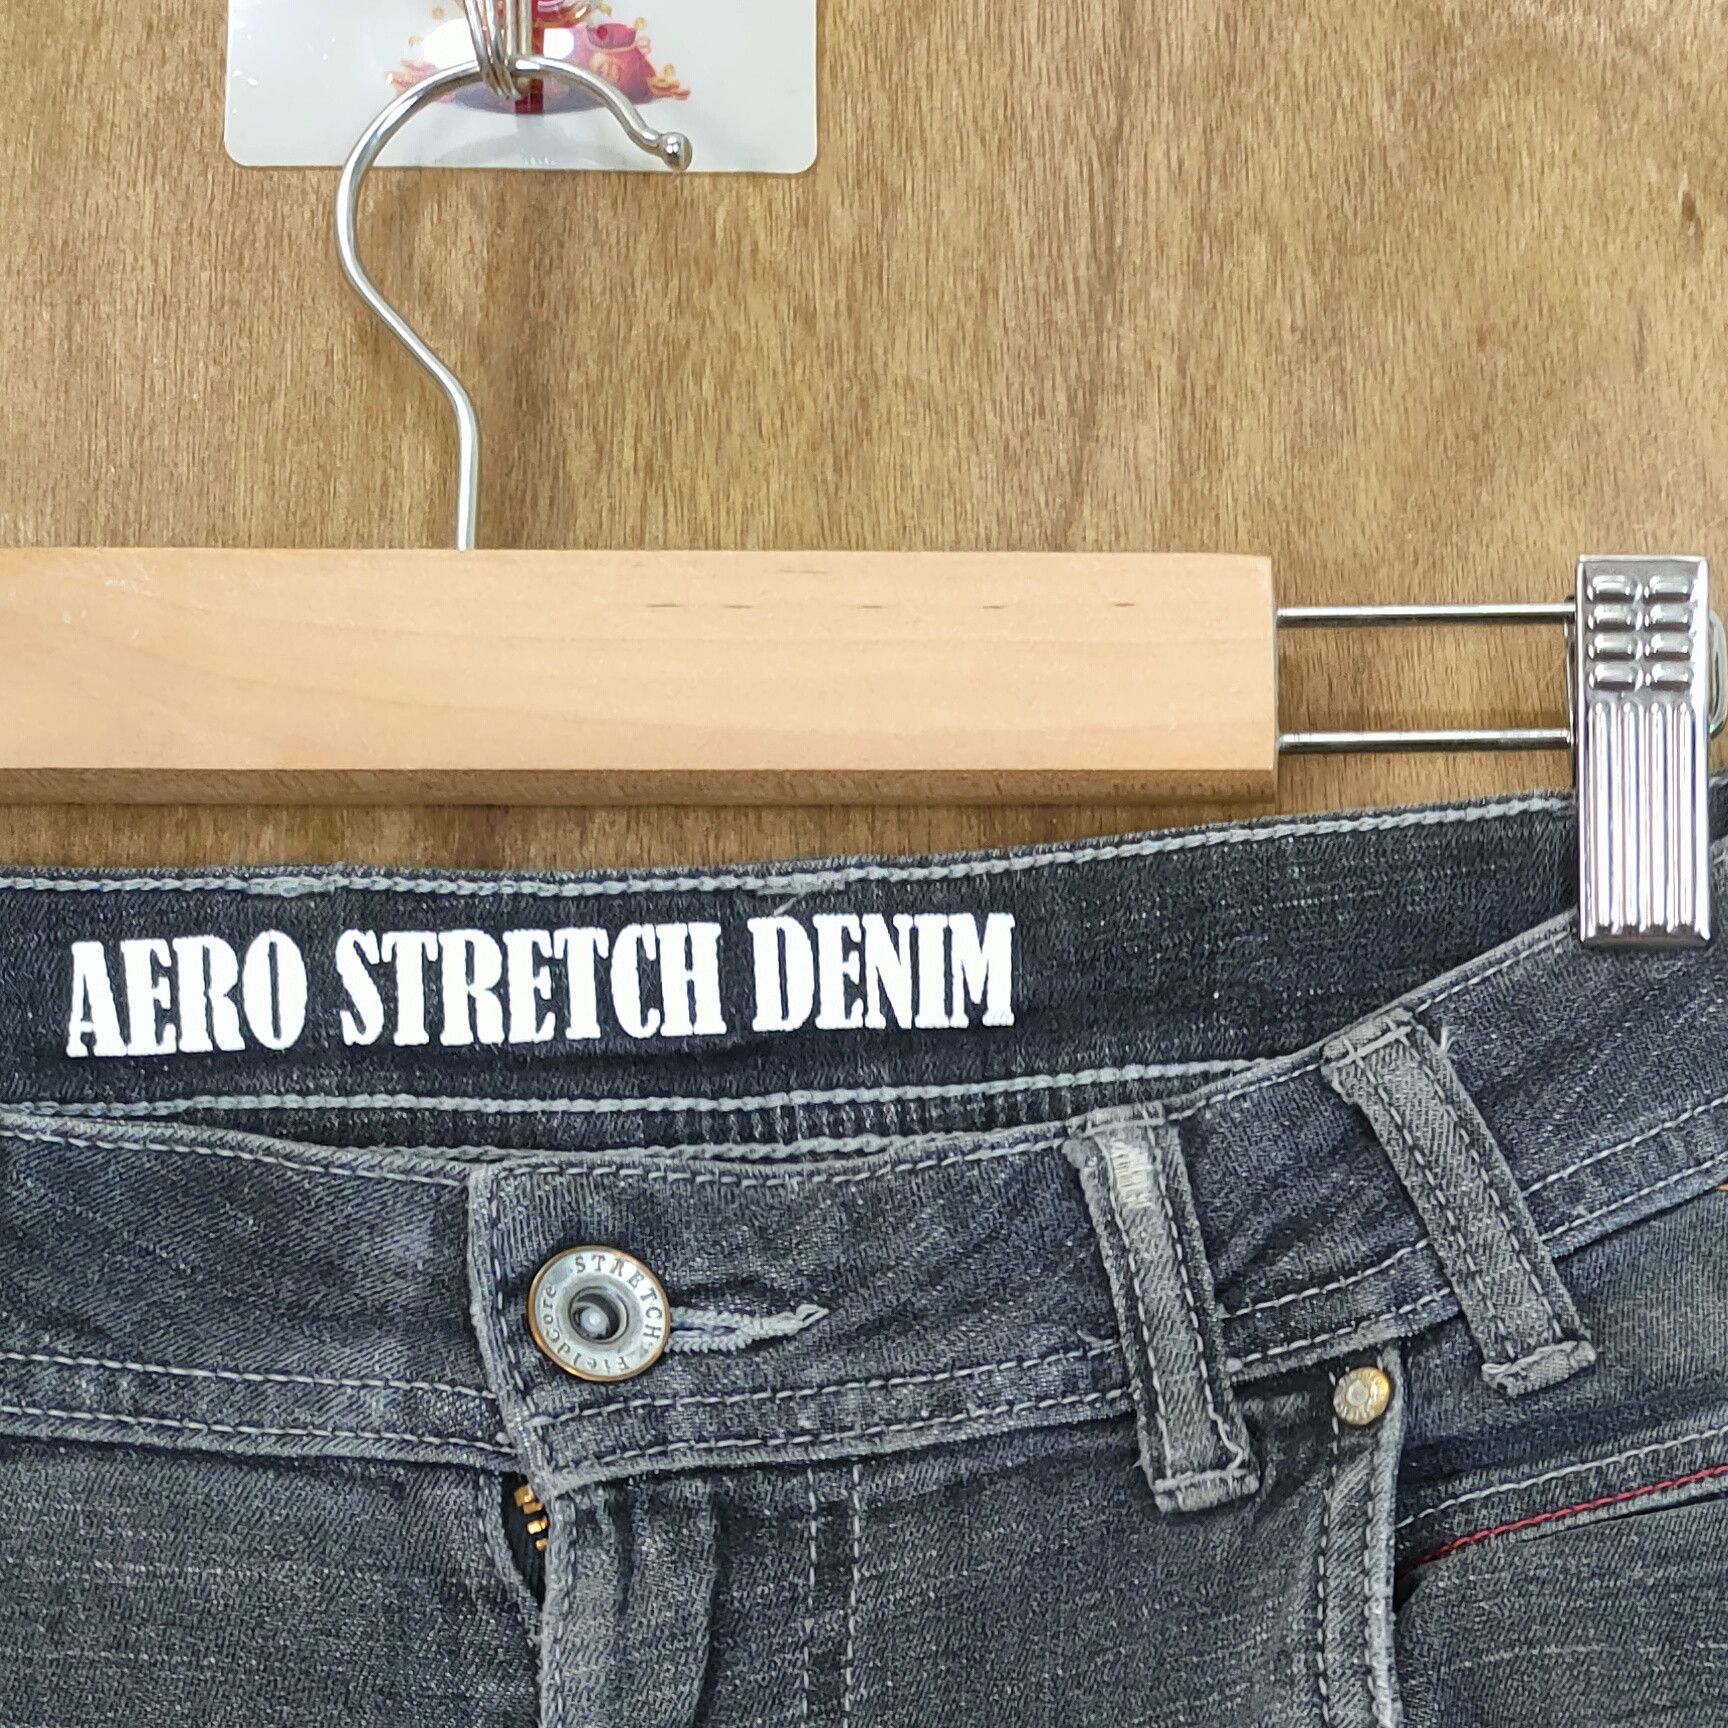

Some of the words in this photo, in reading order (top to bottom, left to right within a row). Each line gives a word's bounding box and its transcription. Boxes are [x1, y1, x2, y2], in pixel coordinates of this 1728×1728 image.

[66, 929, 308, 1057] AERO
[335, 922, 727, 1046] STRETCH
[747, 912, 1016, 1031] DENIM
[574, 1253, 663, 1341] STRETCH
